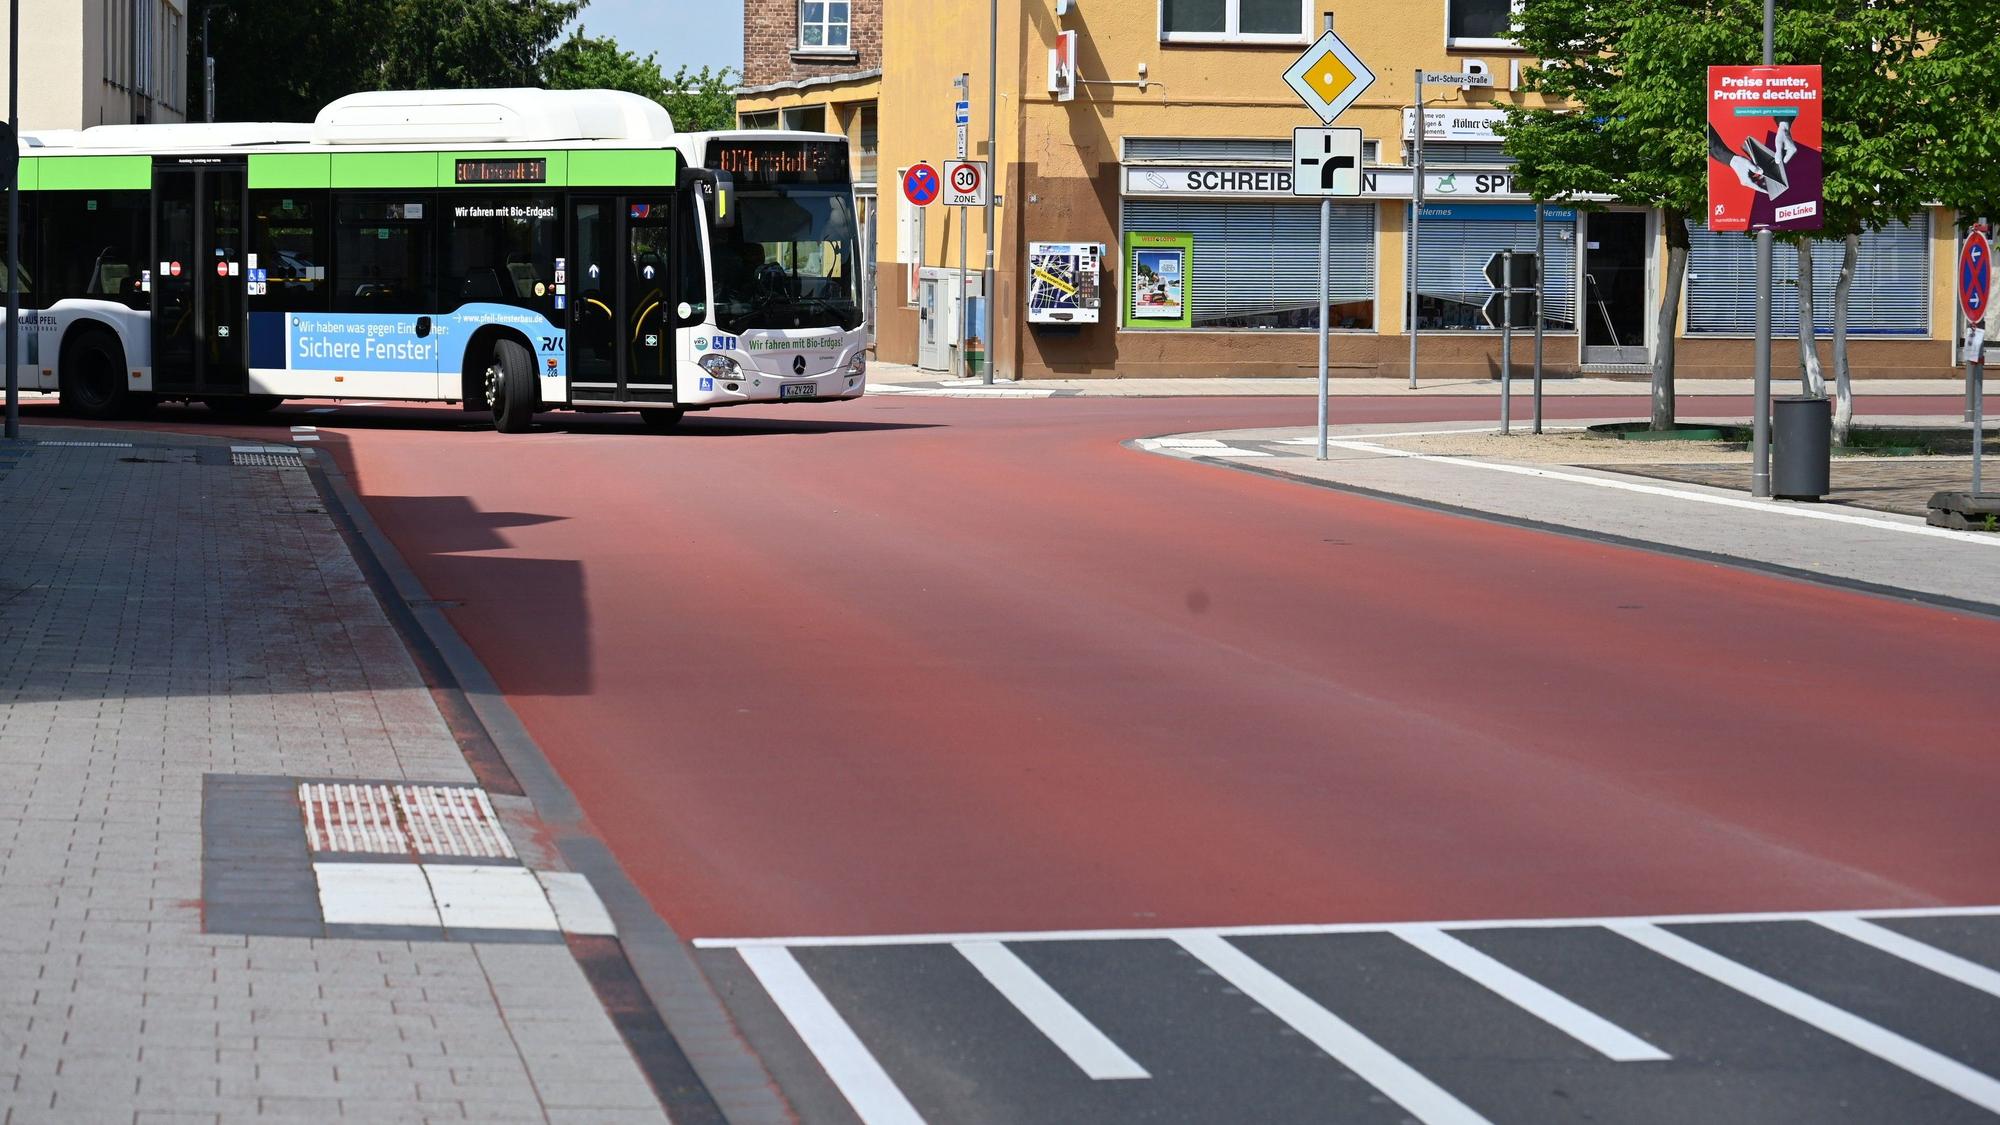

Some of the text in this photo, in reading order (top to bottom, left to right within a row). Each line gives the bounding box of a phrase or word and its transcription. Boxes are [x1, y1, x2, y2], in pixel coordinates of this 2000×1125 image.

[1426, 74, 1488, 85] Carl-Schurz-Straße
[1721, 76, 1809, 88] Preise runter,
[1714, 89, 1817, 100] Profite deckeln!
[957, 172, 974, 186] 30
[1186, 170, 1377, 192] SCHREIBN
[954, 195, 976, 204] ZONE
[455, 206, 554, 219] Wir fahren mit Bio-Erdgas!
[1422, 208, 1452, 216] Hermes
[1543, 209, 1572, 217] Hermes
[1778, 205, 1814, 219] Die Linke
[39, 316, 57, 325] PFEIL
[463, 313, 543, 323] www.pfeil-fensterbau.de
[300, 320, 449, 337] Wir haben was gegen Einbher:
[299, 337, 360, 358] Sichere
[749, 336, 844, 350] Wir fahren mit Bio-Erdgas!
